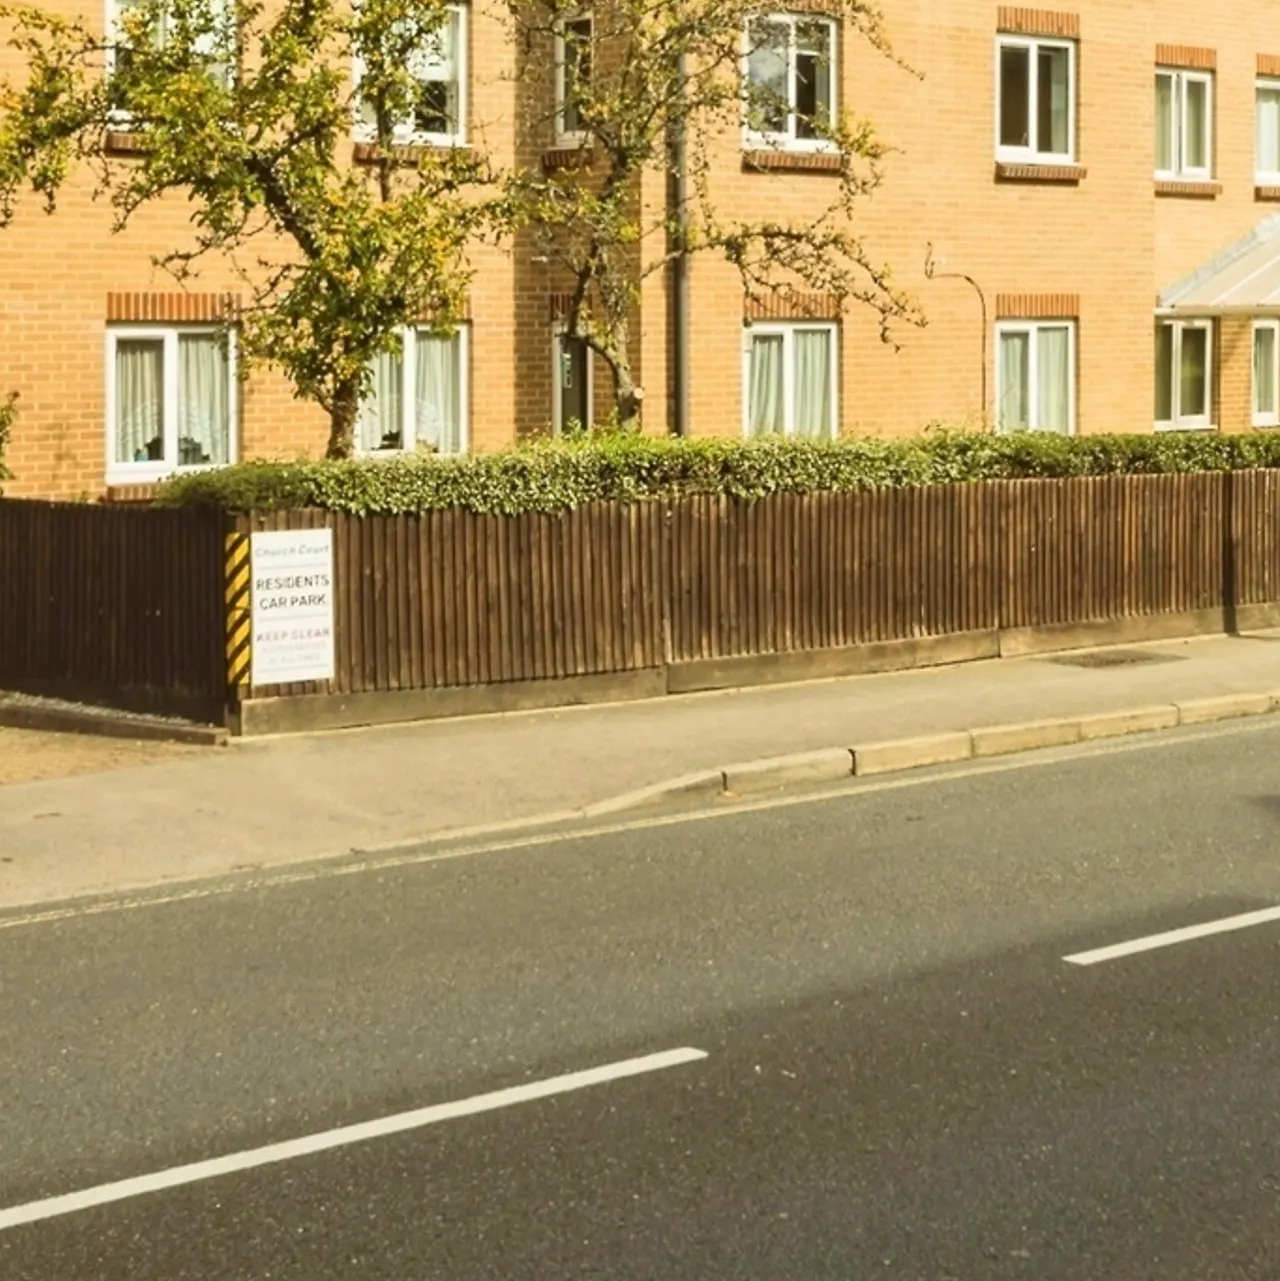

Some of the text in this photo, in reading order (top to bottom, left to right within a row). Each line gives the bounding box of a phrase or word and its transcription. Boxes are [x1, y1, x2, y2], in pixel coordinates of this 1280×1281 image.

[255, 574, 330, 590] RESIDENTS
[259, 594, 327, 610] CAR PARK
[256, 627, 330, 642] KEEP CLEAR
